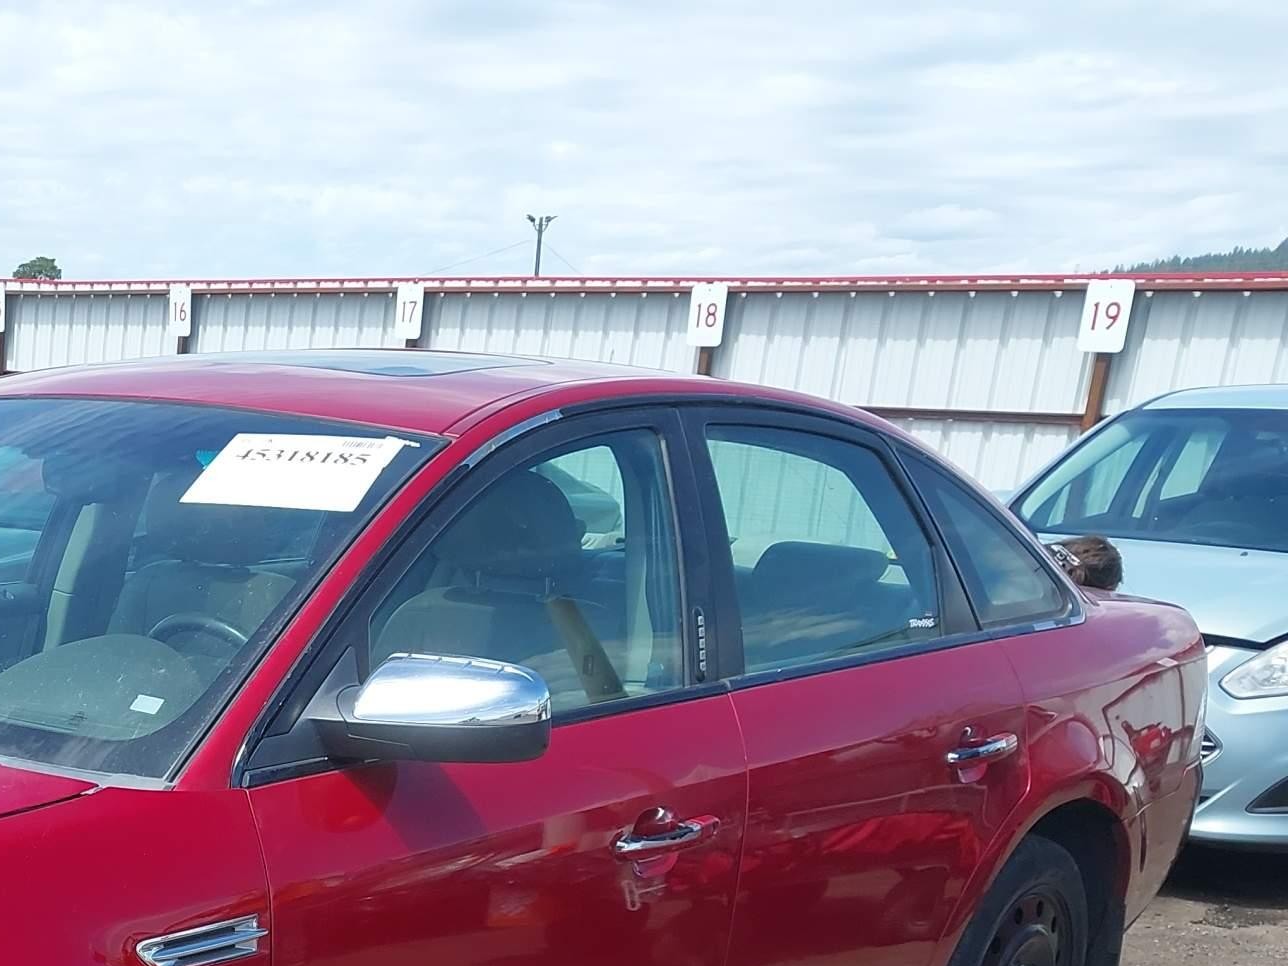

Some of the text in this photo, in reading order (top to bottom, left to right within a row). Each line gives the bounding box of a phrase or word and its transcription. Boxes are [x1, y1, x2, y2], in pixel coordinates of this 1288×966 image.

[174, 301, 187, 322] 16
[402, 300, 418, 323] 17
[696, 302, 718, 329] 18
[1090, 301, 1122, 331] 19
[235, 448, 372, 467] 45318185
